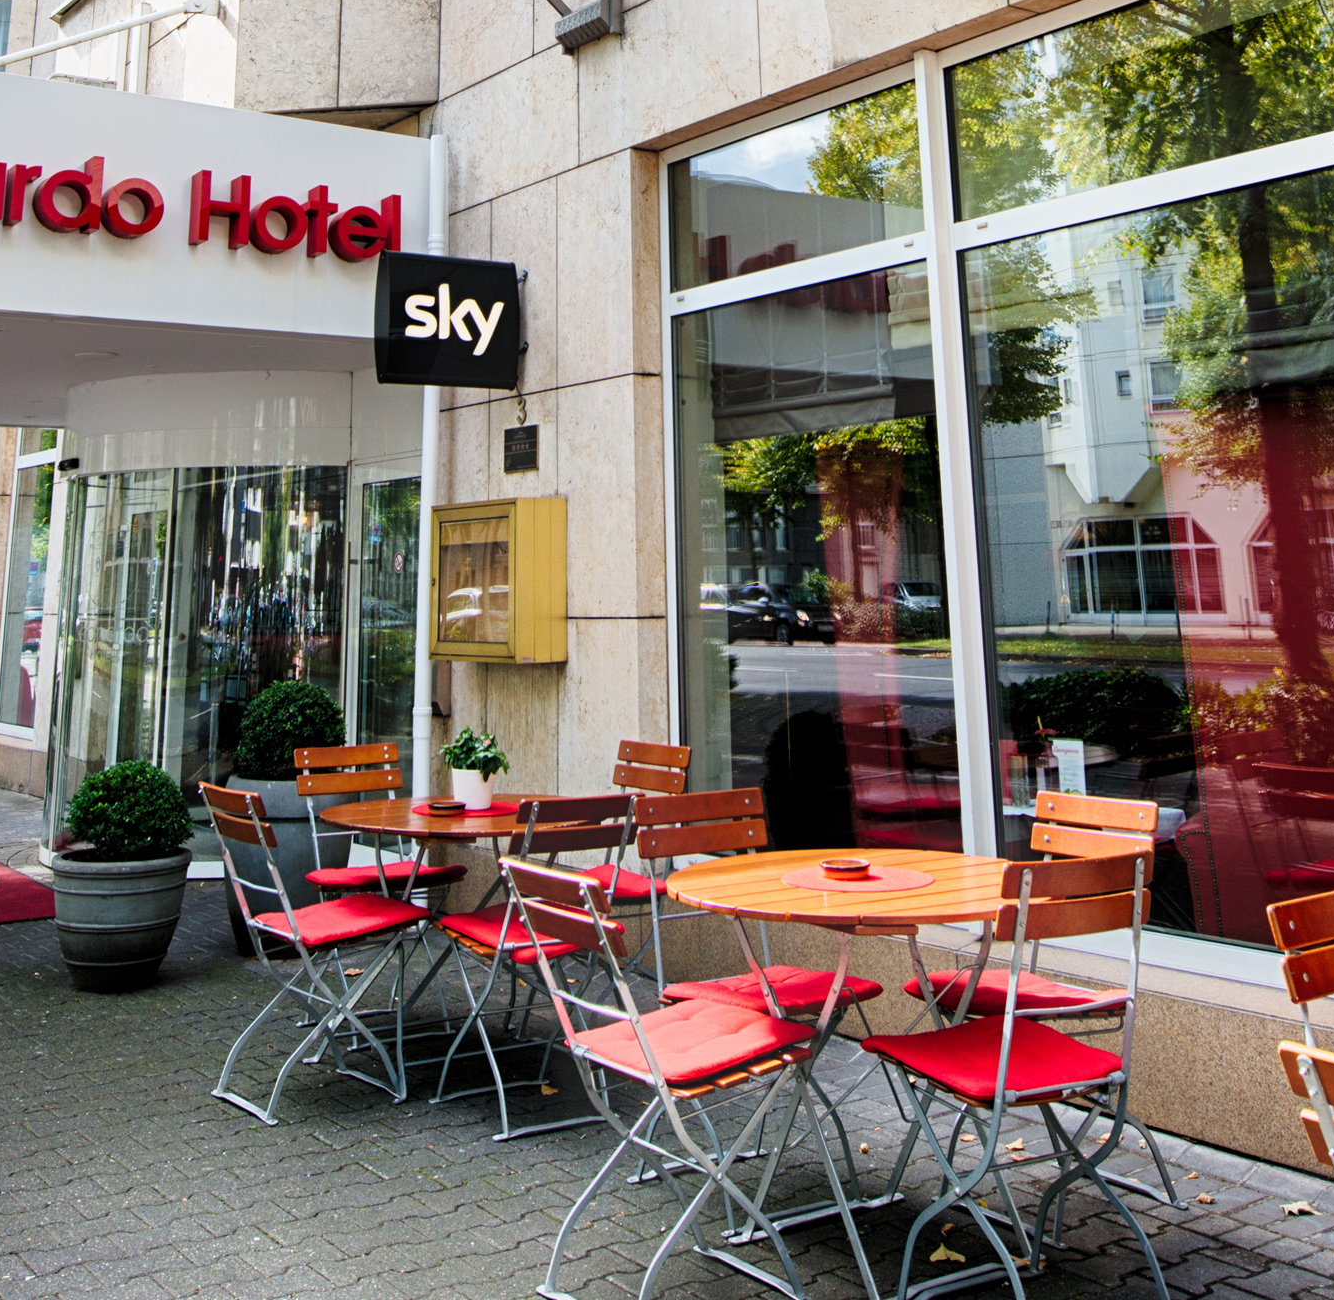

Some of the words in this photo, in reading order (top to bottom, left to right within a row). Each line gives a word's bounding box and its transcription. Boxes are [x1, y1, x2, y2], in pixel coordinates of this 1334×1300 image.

[189, 168, 401, 263] Hotel
[404, 283, 505, 356] sky
[516, 396, 526, 425] 3
